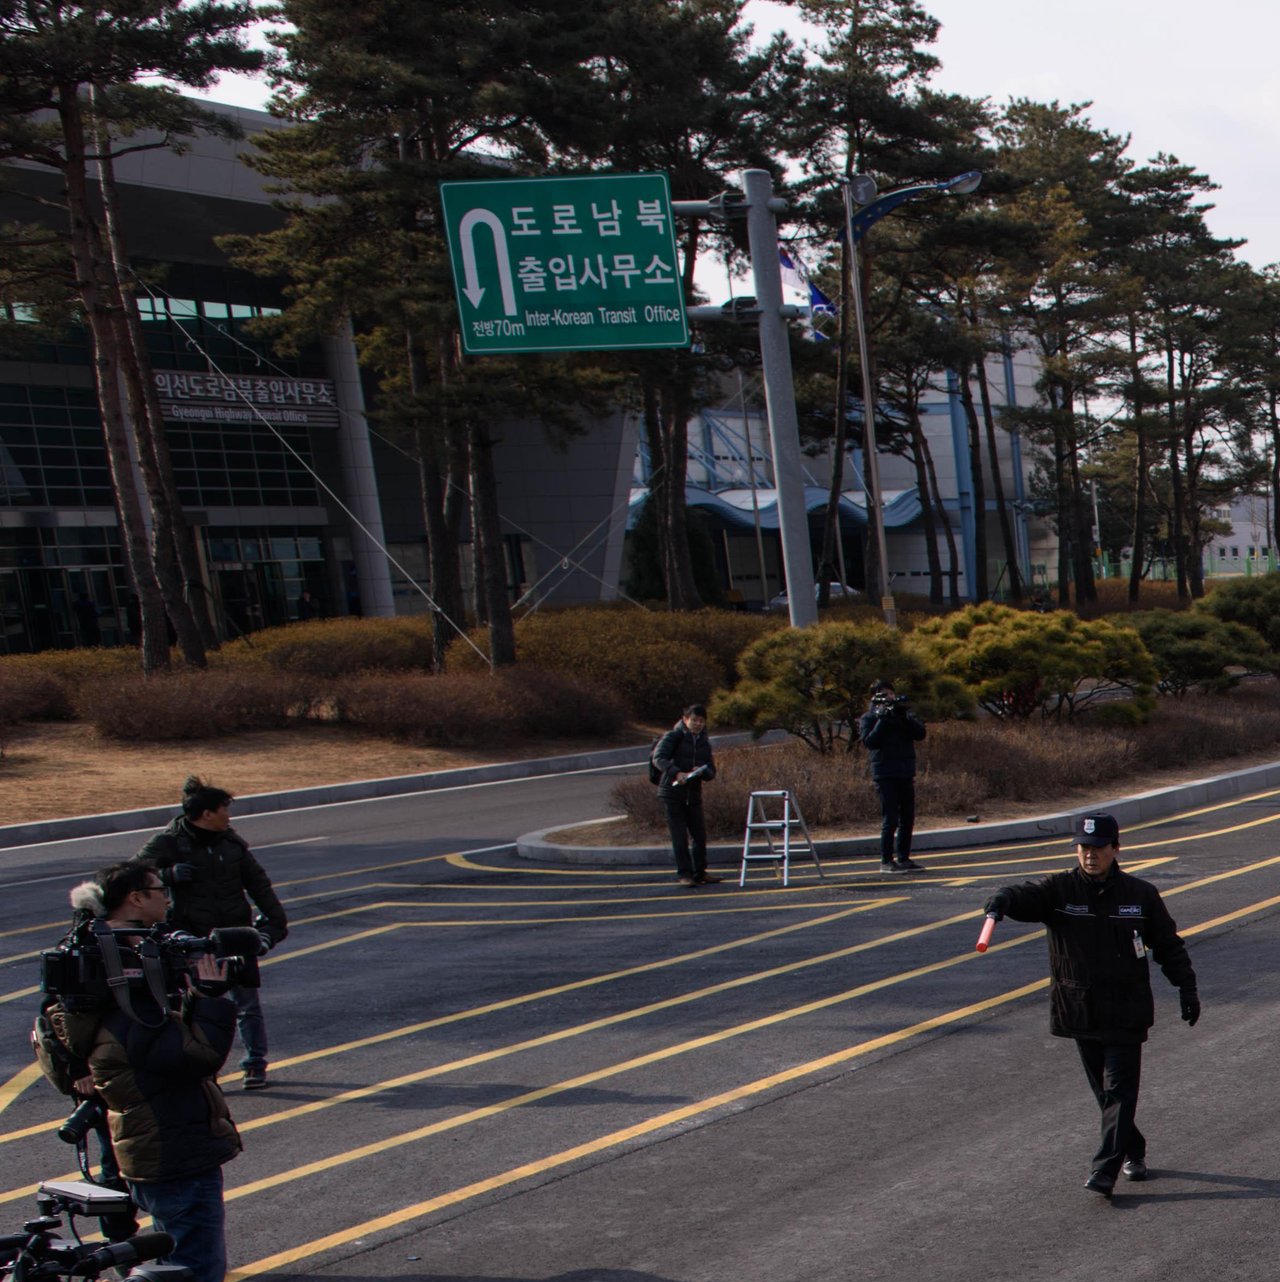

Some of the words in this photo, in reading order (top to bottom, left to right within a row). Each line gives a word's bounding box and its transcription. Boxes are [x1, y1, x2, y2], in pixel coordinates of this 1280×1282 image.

[517, 253, 675, 293] 출입사무소
[525, 309, 594, 327] Inter-Korean
[599, 307, 637, 324] Transit
[645, 305, 680, 323] Office
[472, 319, 525, 338] 전방70m
[154, 373, 332, 404] 의선도로남북출입사무소
[215, 407, 252, 422] Highway
[282, 409, 308, 423] Office
